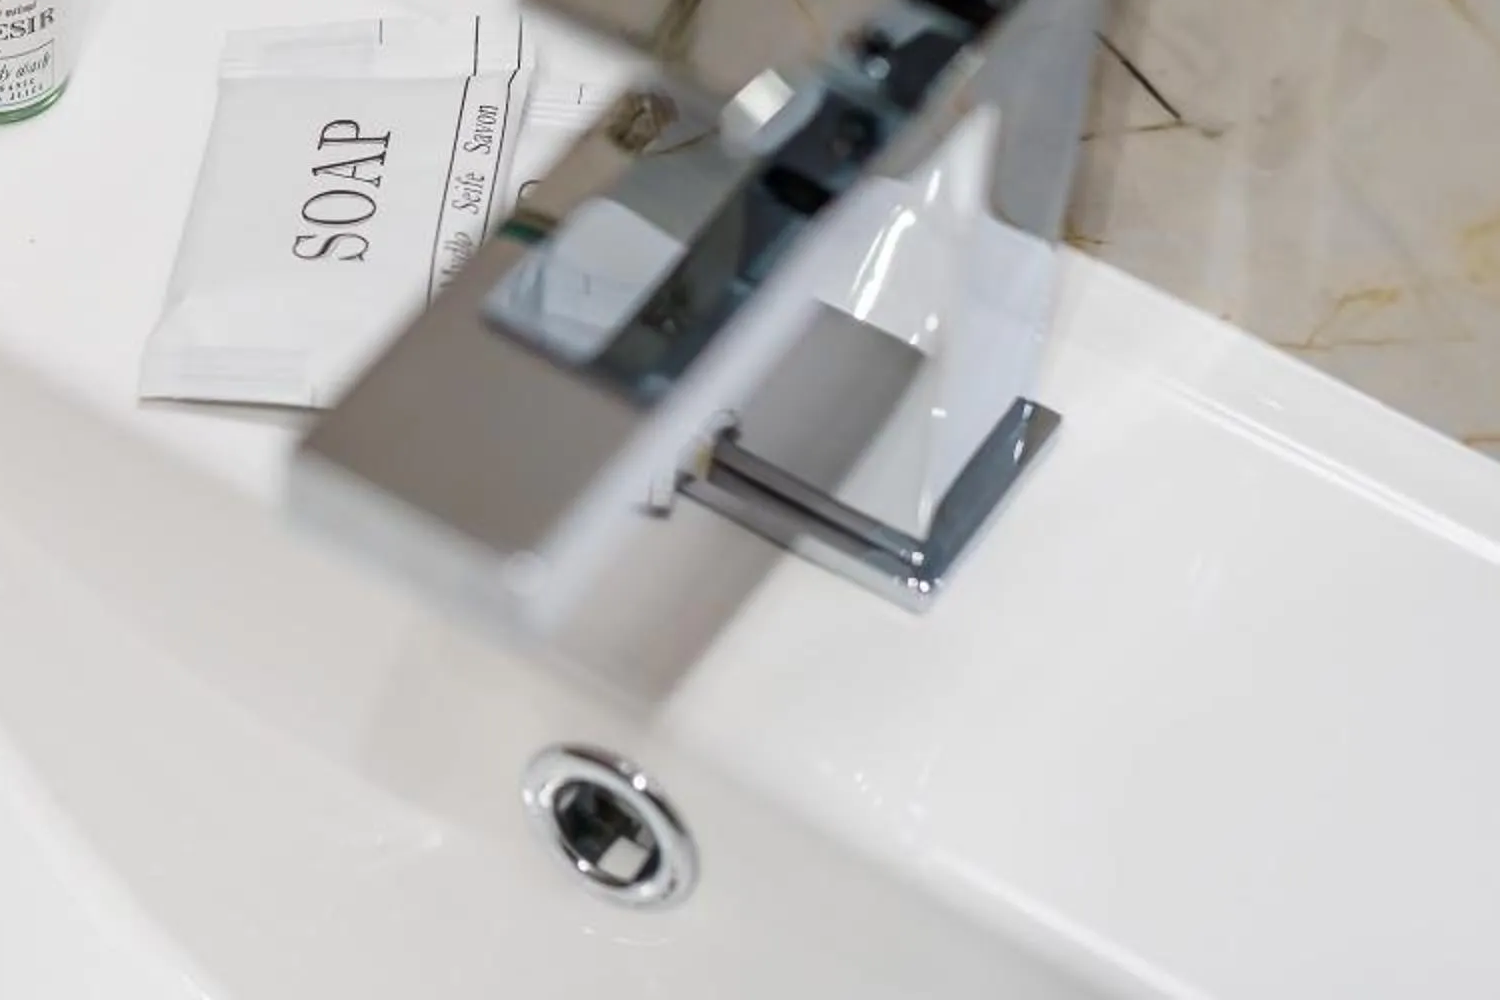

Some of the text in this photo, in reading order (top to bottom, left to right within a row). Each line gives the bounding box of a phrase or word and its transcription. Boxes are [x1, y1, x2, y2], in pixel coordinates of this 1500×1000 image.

[15, 51, 51, 79] wash
[462, 103, 500, 156] Savon
[292, 118, 392, 262] SOAP
[451, 169, 486, 216] Seife
